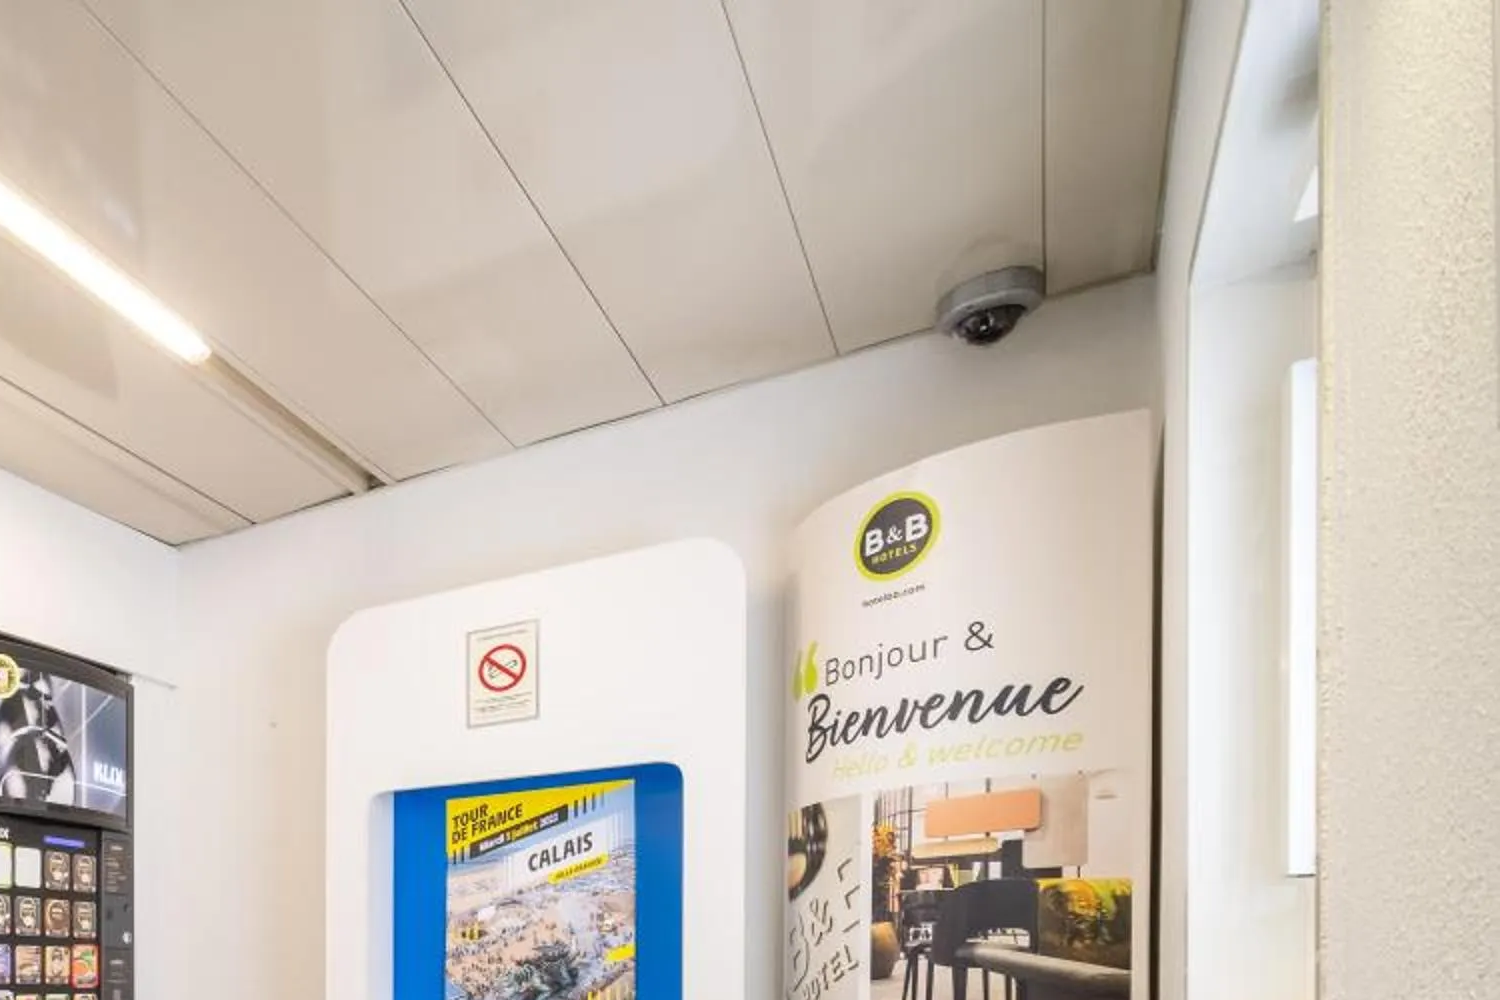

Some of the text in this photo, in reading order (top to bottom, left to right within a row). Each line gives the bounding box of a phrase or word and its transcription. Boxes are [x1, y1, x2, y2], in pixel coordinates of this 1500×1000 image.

[865, 513, 929, 557] B&B
[870, 543, 917, 565] HOTELS
[825, 621, 995, 686] Bonjour &
[805, 676, 1084, 764] Bienvenue
[93, 760, 124, 787] KLIX
[832, 752, 891, 781] Hello
[928, 731, 1085, 767] welcome
[451, 803, 490, 828] TOUR
[451, 830, 468, 844] DE
[471, 803, 524, 837] FRANCE
[528, 831, 593, 871] CALAIS
